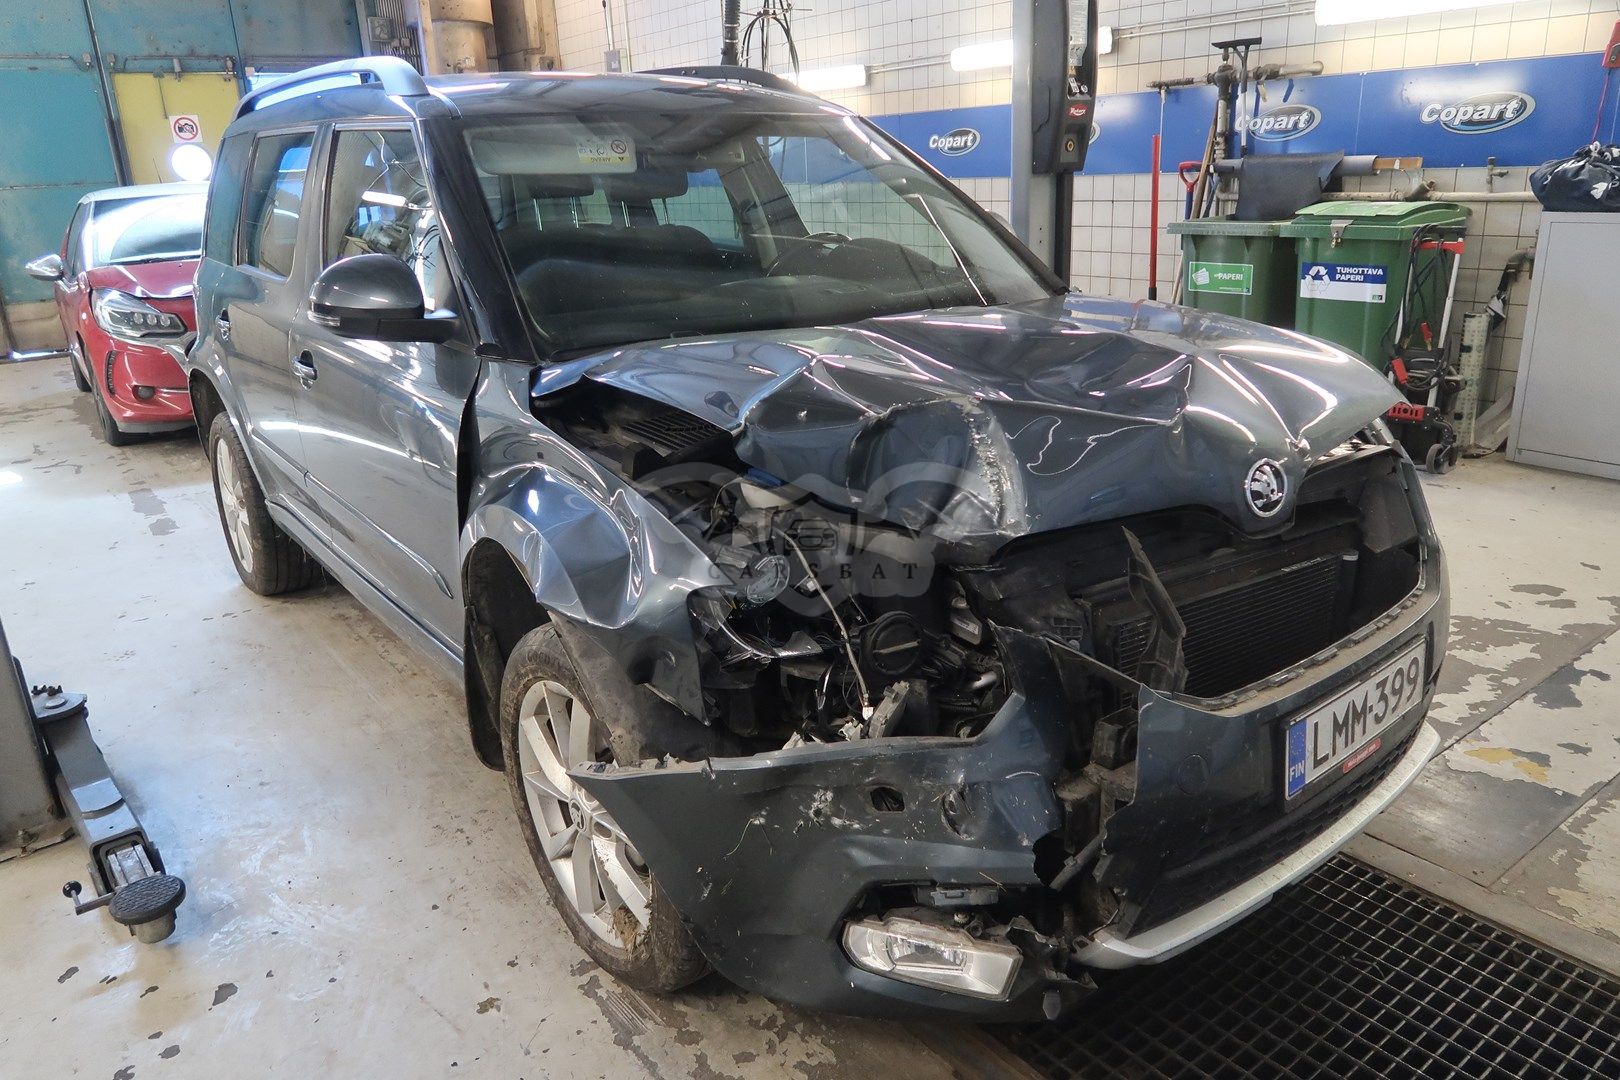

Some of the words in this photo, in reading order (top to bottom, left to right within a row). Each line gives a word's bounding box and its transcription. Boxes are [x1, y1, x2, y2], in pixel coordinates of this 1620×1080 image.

[1420, 98, 1521, 126] Copart
[929, 132, 974, 150] Copart
[1218, 272, 1243, 281] PAPERI
[1335, 274, 1364, 282] PAPERI
[1336, 267, 1384, 276] TUHOTTAVA
[1313, 657, 1420, 769] LMM-399
[1289, 760, 1305, 782] FIN
